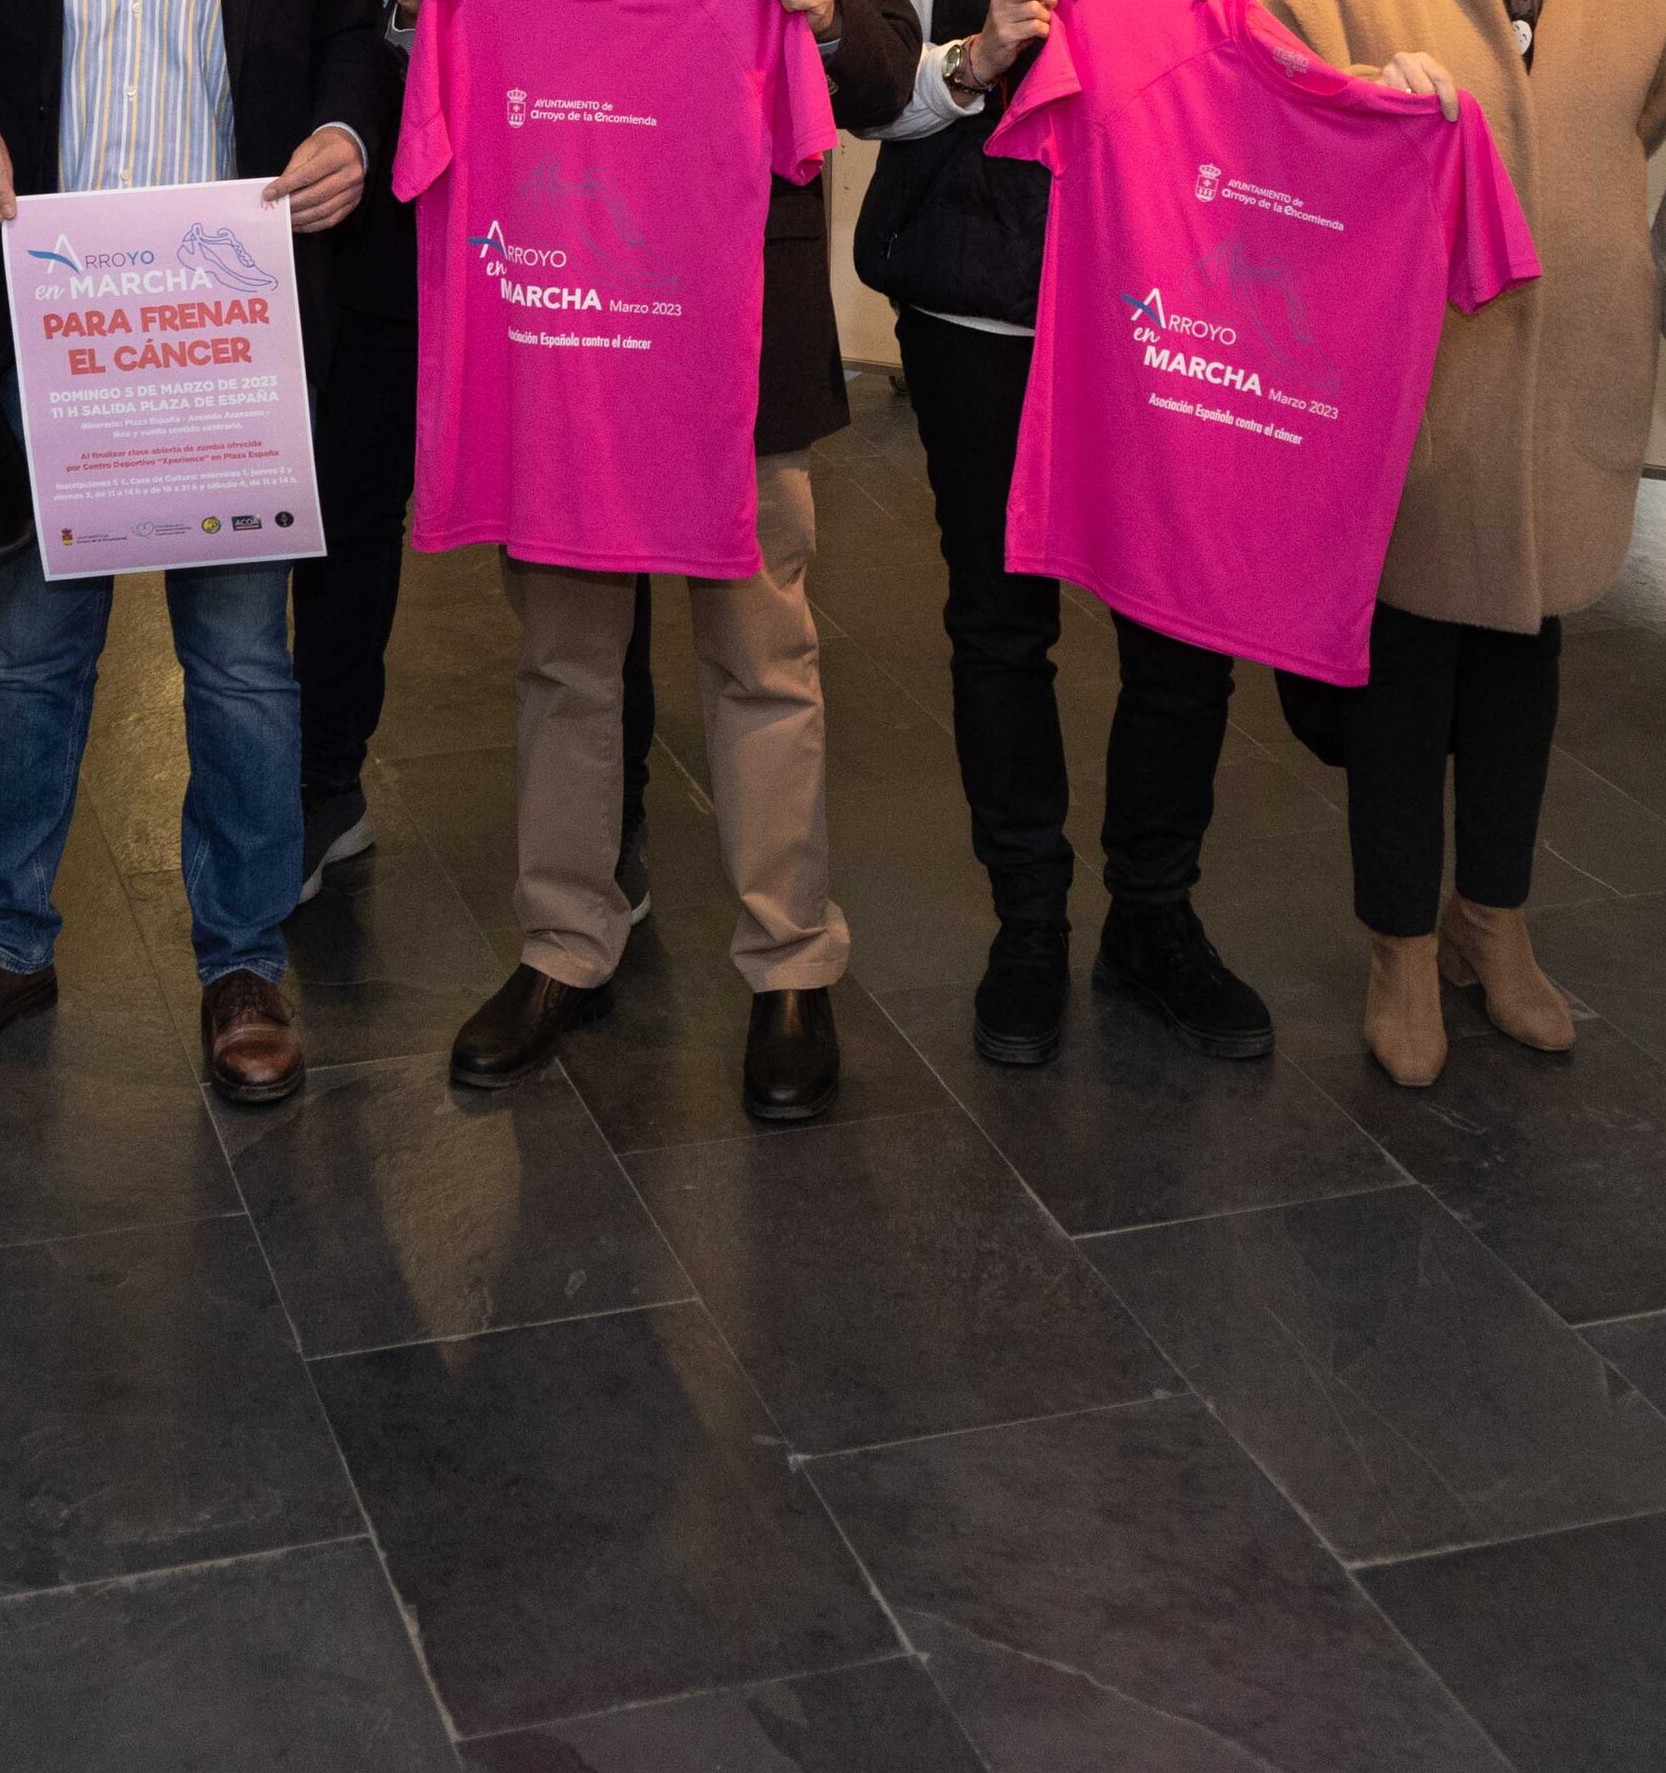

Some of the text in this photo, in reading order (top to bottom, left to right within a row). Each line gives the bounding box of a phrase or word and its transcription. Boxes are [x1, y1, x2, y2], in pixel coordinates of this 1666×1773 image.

[534, 99, 613, 111] AYUNTAMIENTO de
[567, 111, 581, 121] de
[583, 111, 593, 121] la
[1227, 179, 1304, 207] AYUNTAMIENTO de
[1258, 198, 1272, 209] de
[1274, 202, 1283, 213] la
[41, 233, 155, 274] ARROYO
[475, 220, 567, 268] ARROYO
[486, 260, 506, 276] en
[34, 266, 213, 301] en MARCHA
[500, 278, 683, 317] MARCHA Marzo 2023
[43, 297, 270, 339] PARA FRENAR
[1128, 288, 1236, 345] ARROYO
[540, 332, 579, 348] Española
[582, 335, 610, 348] contra
[612, 334, 621, 348] el
[623, 336, 652, 350] cáncer
[1133, 326, 1160, 343] en
[68, 338, 252, 376] EL CÁNCER
[50, 375, 278, 405] DOMINGO 5 DE MARZO DE 2023
[1143, 345, 1339, 420] MARCHA Marzo 2023
[51, 389, 280, 418] 11 H SALIDA PLAZA DE ESPAÑA
[1148, 392, 1304, 445] Asociación Española contra el cáncer
[66, 465, 80, 474] por
[83, 463, 112, 471] Centro
[113, 459, 156, 469] Deportivo
[211, 453, 222, 461] en
[223, 451, 247, 460] Plaza
[248, 449, 279, 459] España
[80, 440, 262, 460] Al finalizar clase abierta de zumba ofrecida
